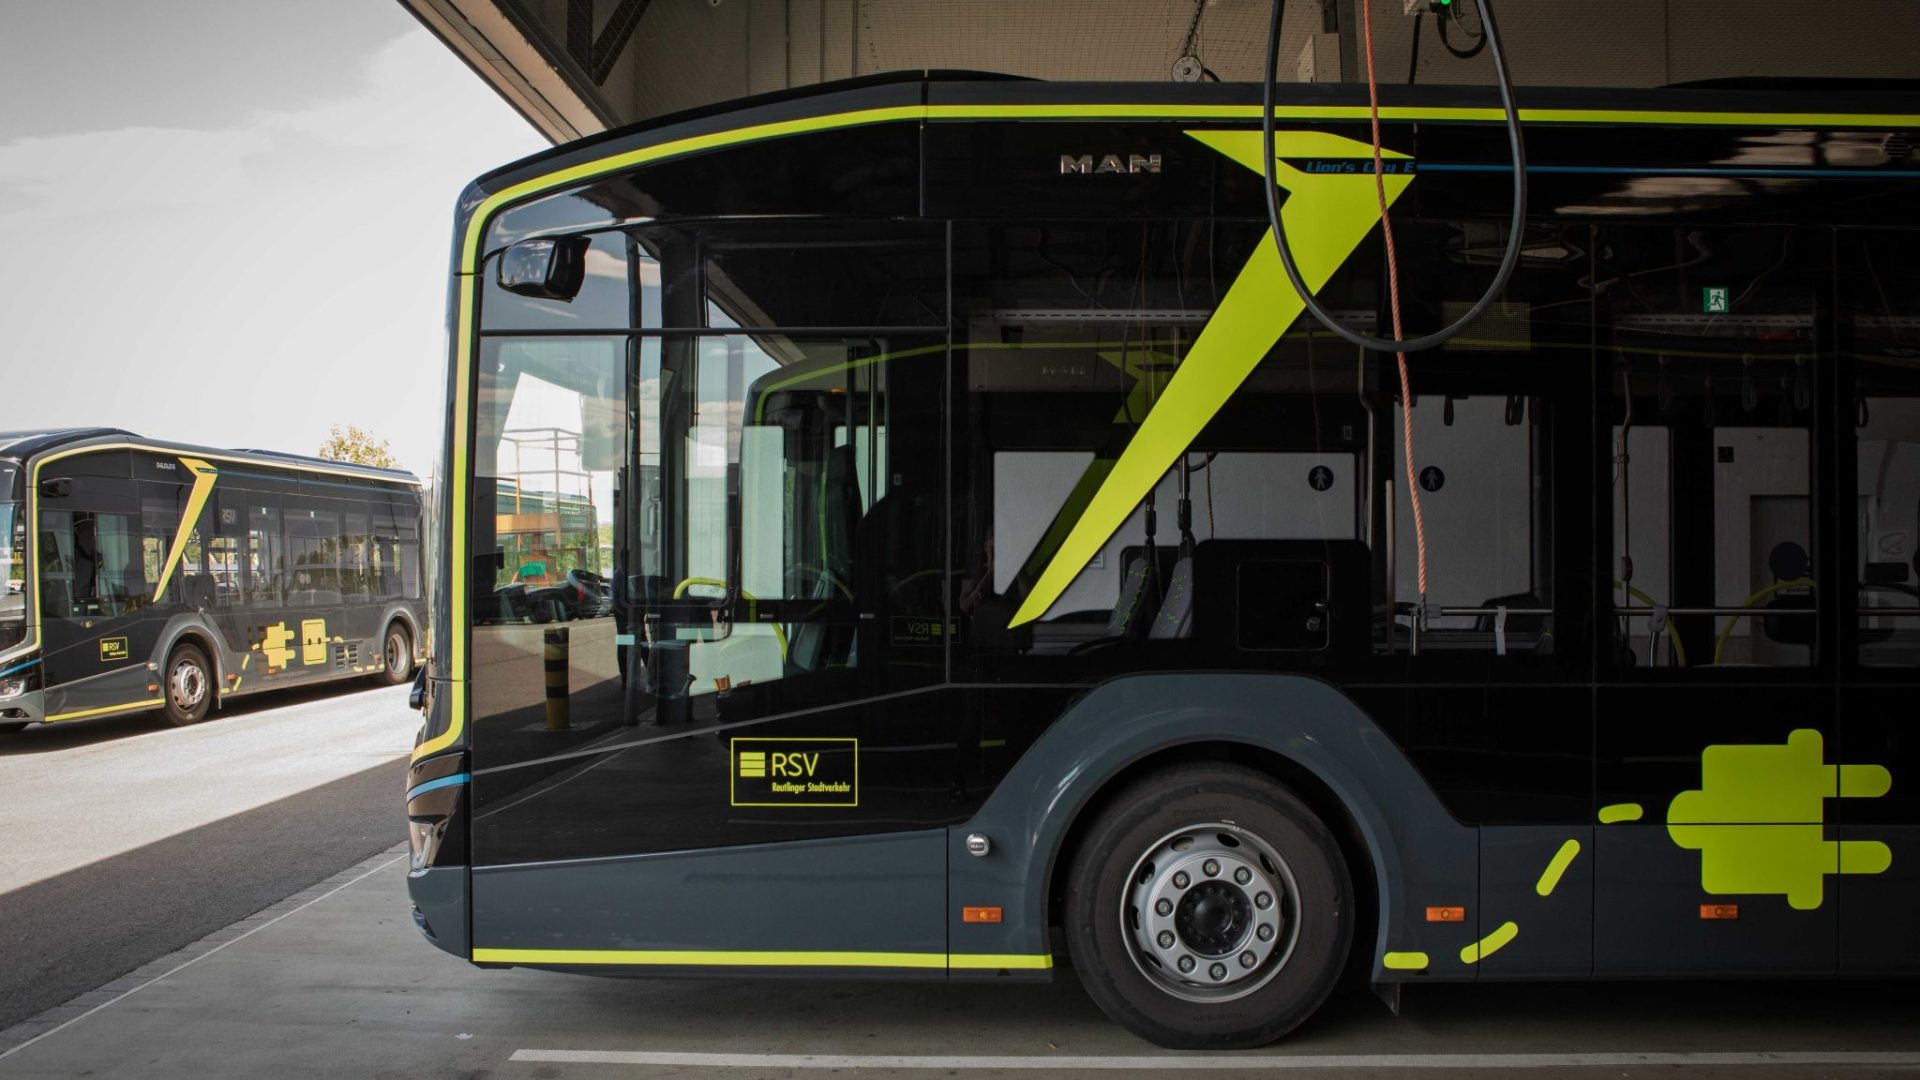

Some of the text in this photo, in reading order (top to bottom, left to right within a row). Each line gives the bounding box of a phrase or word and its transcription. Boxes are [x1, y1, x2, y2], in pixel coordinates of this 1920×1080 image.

[1060, 154, 1162, 175] MAN
[1305, 161, 1415, 173] Lion's Cy E
[772, 752, 819, 777] RSV
[772, 781, 851, 794] Reutlinger Stadtverkehr
